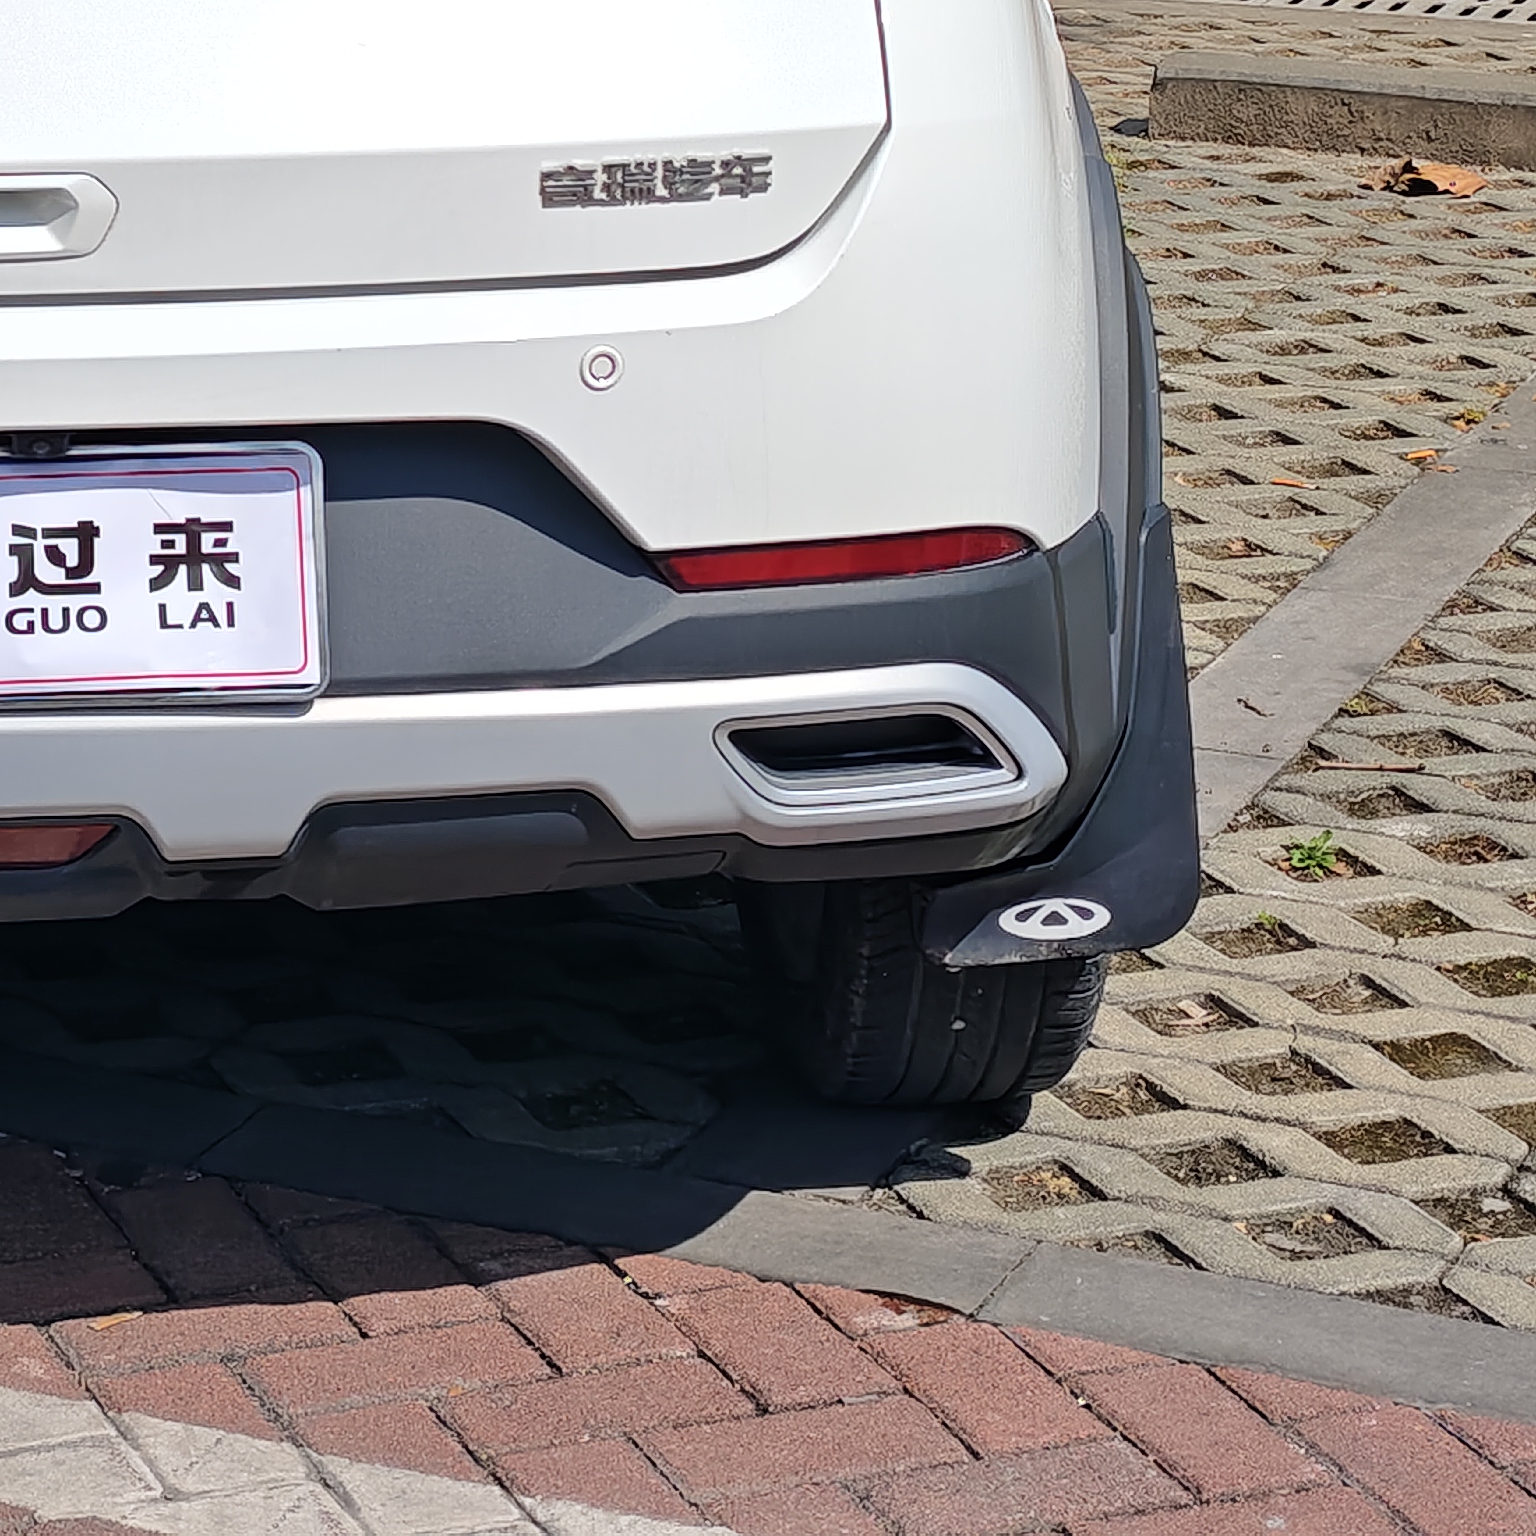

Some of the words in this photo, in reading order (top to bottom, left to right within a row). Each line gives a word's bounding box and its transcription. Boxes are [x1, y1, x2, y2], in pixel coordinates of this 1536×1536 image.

[539, 154, 773, 208] 奇瑞汽车
[5, 606, 108, 634] GUO
[159, 602, 235, 630] LAI
